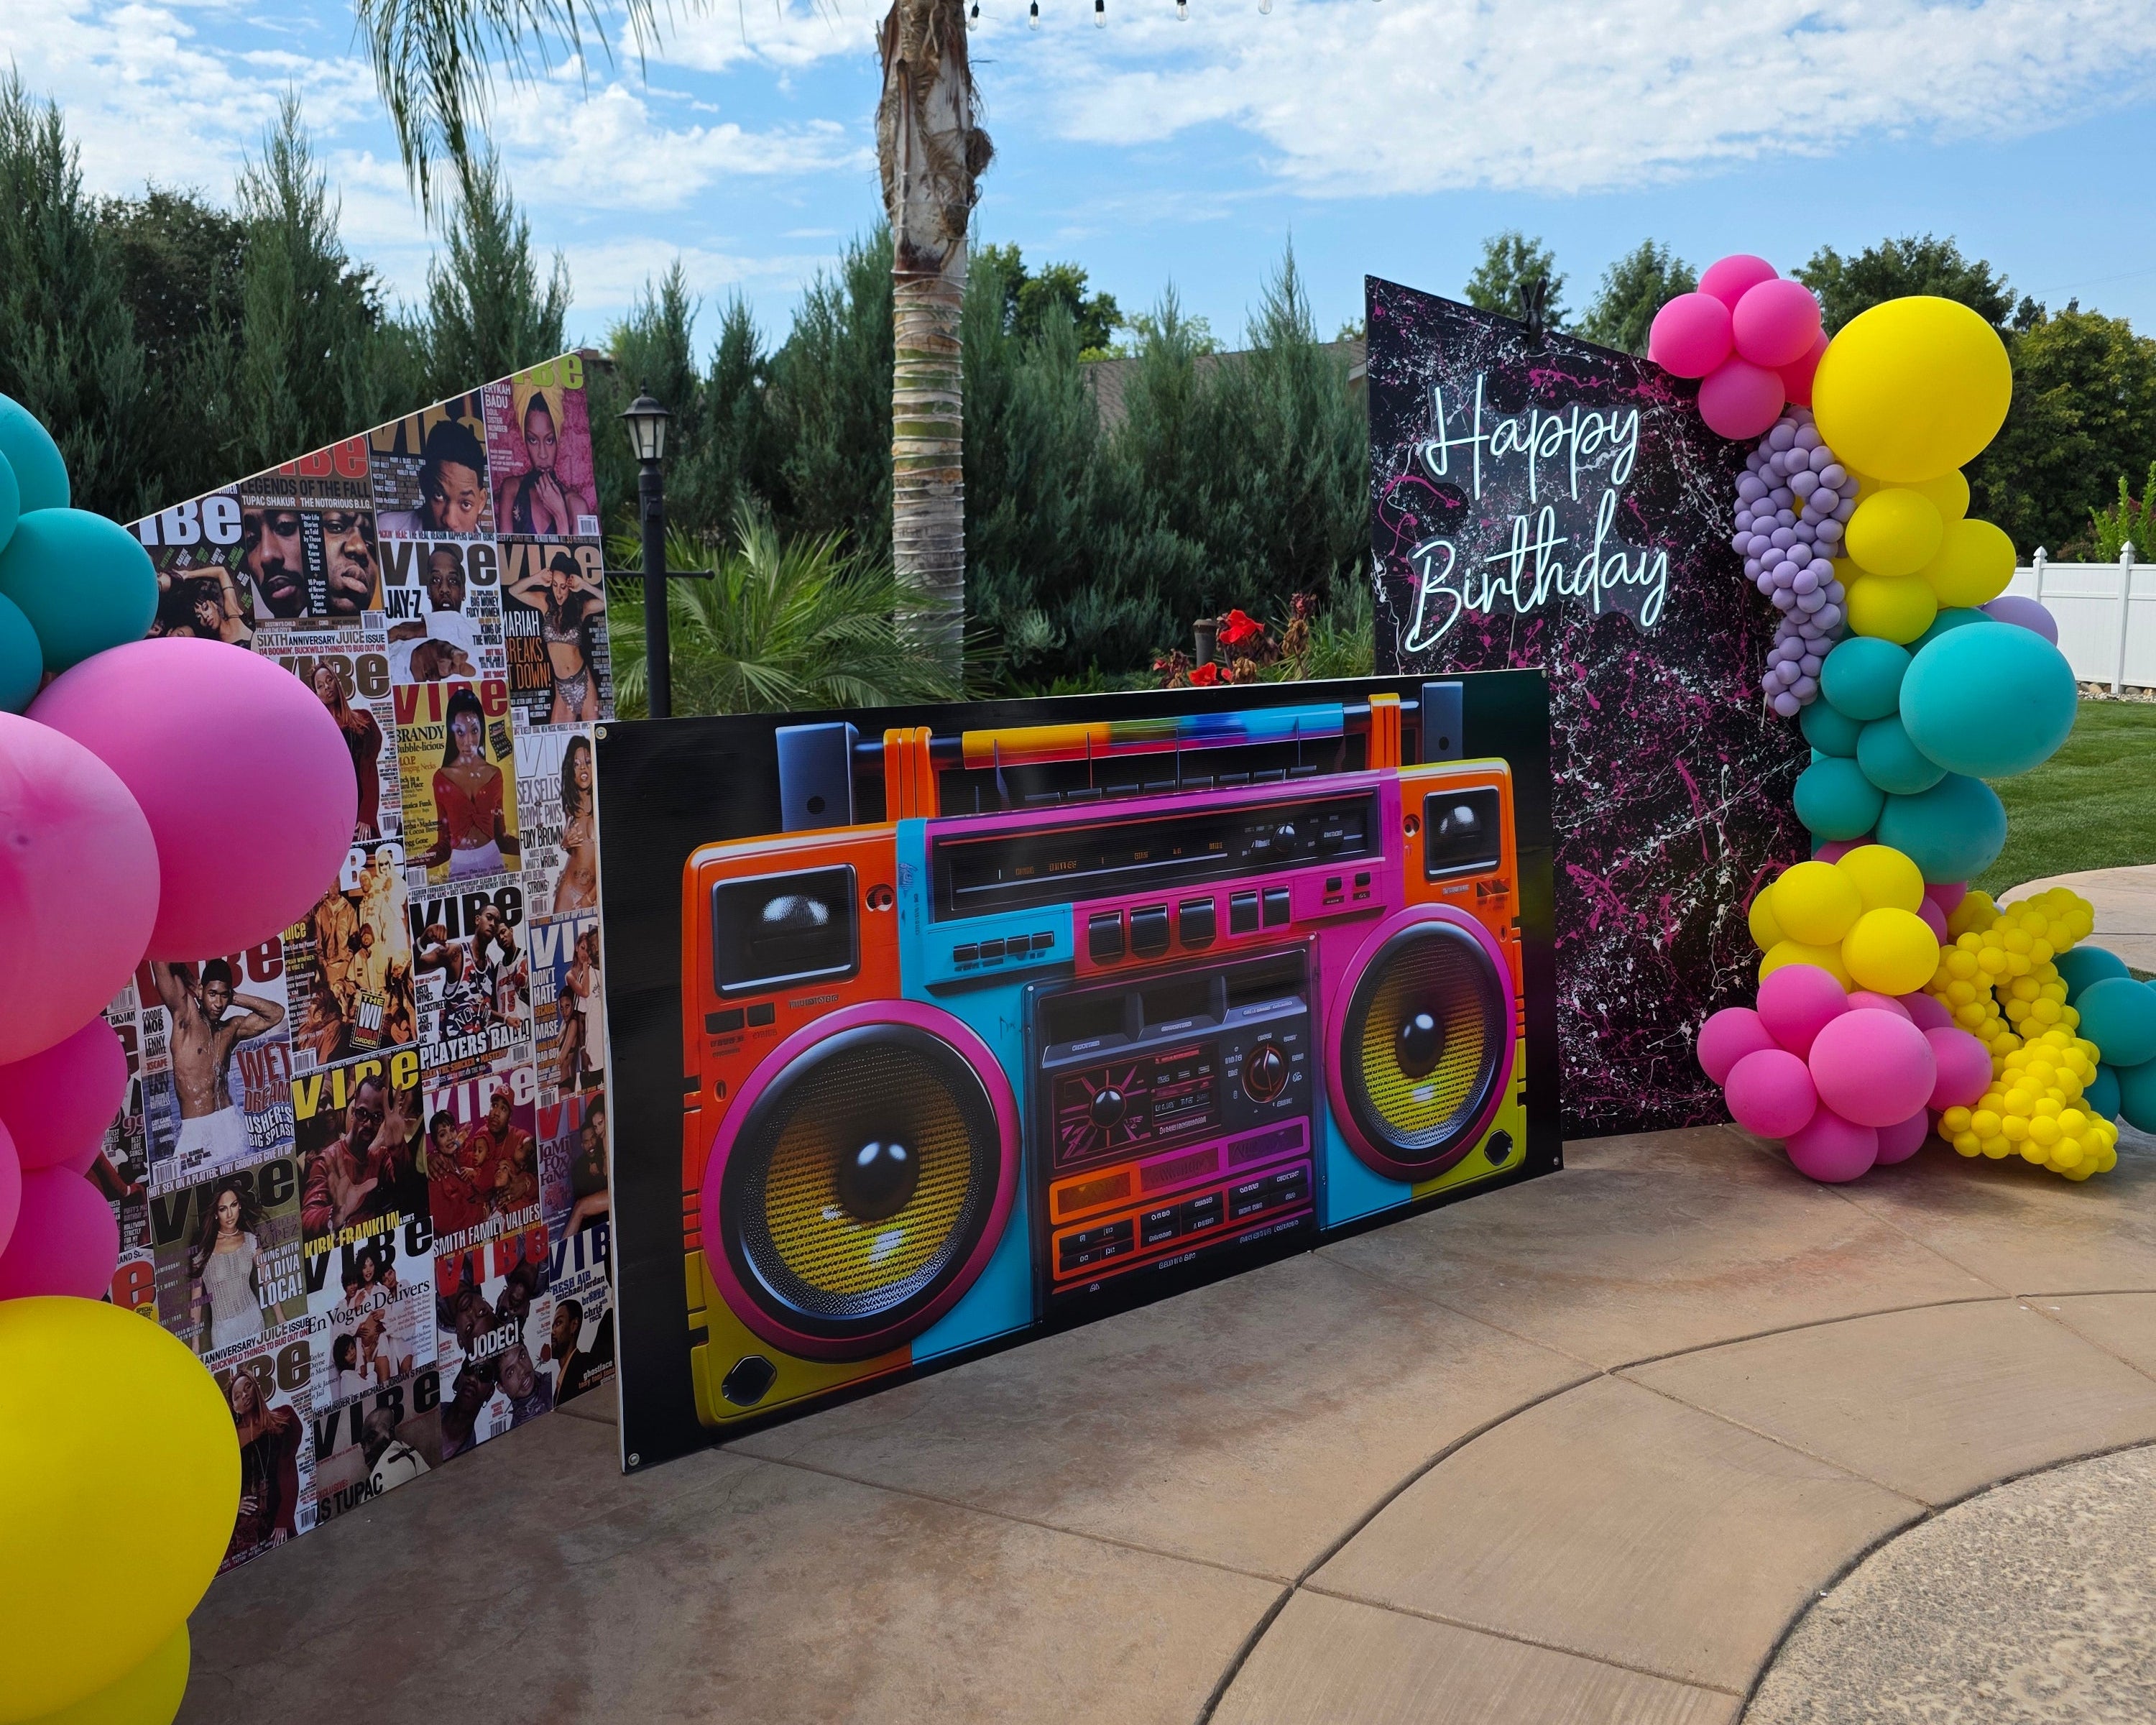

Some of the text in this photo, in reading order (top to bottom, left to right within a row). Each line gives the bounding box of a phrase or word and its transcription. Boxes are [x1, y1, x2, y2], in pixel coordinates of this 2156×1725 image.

[484, 385, 511, 395] ERYKAH
[485, 395, 508, 408] BADU
[1426, 374, 1639, 504] Happy
[241, 477, 371, 497] LEGENDS OF THE FALL
[242, 495, 372, 510] TUPAC SHAKUR THE NOTORIOUS B.I.G.
[1406, 489, 1667, 652] Birthday
[385, 589, 423, 619] JAY-Z
[466, 607, 499, 618] FOXY WOMEN
[471, 595, 499, 607] BIG MONEY
[257, 631, 385, 647] SIXTH ANNIVERSARY JUICE ISSUE
[472, 634, 502, 645] THE WORLD
[481, 623, 502, 634] KING OF
[295, 645, 323, 655] BUCKWILD
[325, 644, 344, 654] THINGS
[346, 644, 352, 653] TO
[365, 643, 374, 652] OUT
[517, 662, 552, 690] DOWN!
[517, 777, 562, 806] SEX SELLS
[519, 804, 562, 828] RHYME PAYS
[520, 824, 563, 850] FOXY BROWN
[540, 854, 559, 868] WRONG
[533, 967, 556, 987] DON'T
[362, 993, 384, 1006] THE
[533, 983, 557, 1006] HATE
[142, 1008, 164, 1021] GOODIE
[360, 1002, 383, 1031] WU
[144, 1018, 165, 1035] MOB
[356, 1027, 378, 1039] WORLD
[491, 1018, 530, 1052] BALL!
[535, 1019, 559, 1041] MASE
[144, 1035, 165, 1049] LENNY
[354, 1036, 377, 1047] ORDER
[420, 1031, 487, 1070] PLAYERS
[236, 1041, 292, 1090] WET
[244, 1081, 291, 1113] DREAM
[244, 1105, 293, 1133] USHER'S
[249, 1133, 264, 1148] BIG
[148, 1184, 160, 1198] HOT
[162, 1182, 175, 1194] SEX
[175, 1179, 185, 1190] ON
[186, 1177, 191, 1186] A
[192, 1169, 218, 1184] PLATTER:
[219, 1164, 234, 1177] WHY
[234, 1154, 263, 1171] GROUPIES
[264, 1149, 277, 1161] GIVE
[285, 1144, 293, 1154] UP
[304, 1210, 400, 1259] KIRK FRANKLIN
[433, 1230, 466, 1258] SMITH
[468, 1216, 505, 1245] FAMILY
[506, 1202, 541, 1230] VALUES
[256, 1241, 300, 1266] LIVING WITH
[257, 1254, 300, 1284] LA DIVA
[577, 1271, 591, 1284] AIR
[259, 1271, 303, 1310] LOCA!
[584, 1275, 605, 1293] jordan
[308, 1279, 430, 1335] En Vogue Delivers
[584, 1303, 604, 1320] chris
[205, 1317, 309, 1366] ANNIVERSARY JUICE ISSUE
[211, 1333, 299, 1373] BUCKWILD THINGS TO BUG OUT
[313, 1361, 437, 1420] THE MURDER OF MICHAEL FATHER
[333, 1472, 384, 1514] TUPAC
